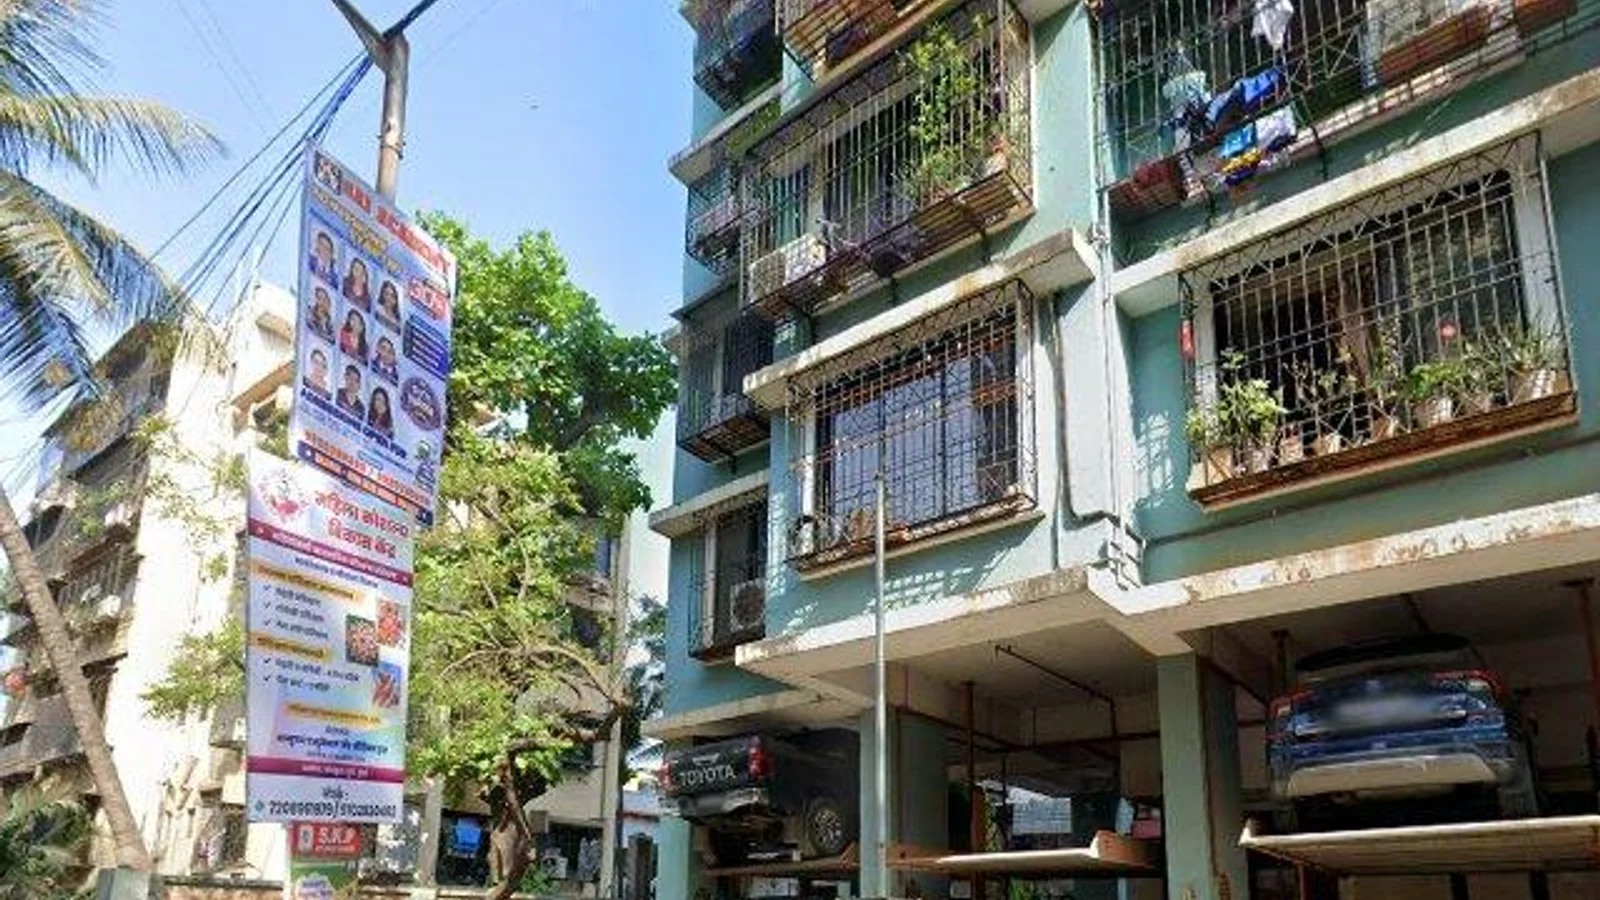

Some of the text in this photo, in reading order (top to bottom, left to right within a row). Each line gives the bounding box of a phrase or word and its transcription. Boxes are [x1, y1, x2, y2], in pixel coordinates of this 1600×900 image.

[363, 426, 389, 448] OPEN
[315, 491, 359, 521] महिला
[328, 517, 372, 551] विकास
[680, 764, 737, 787] TOYOTA
